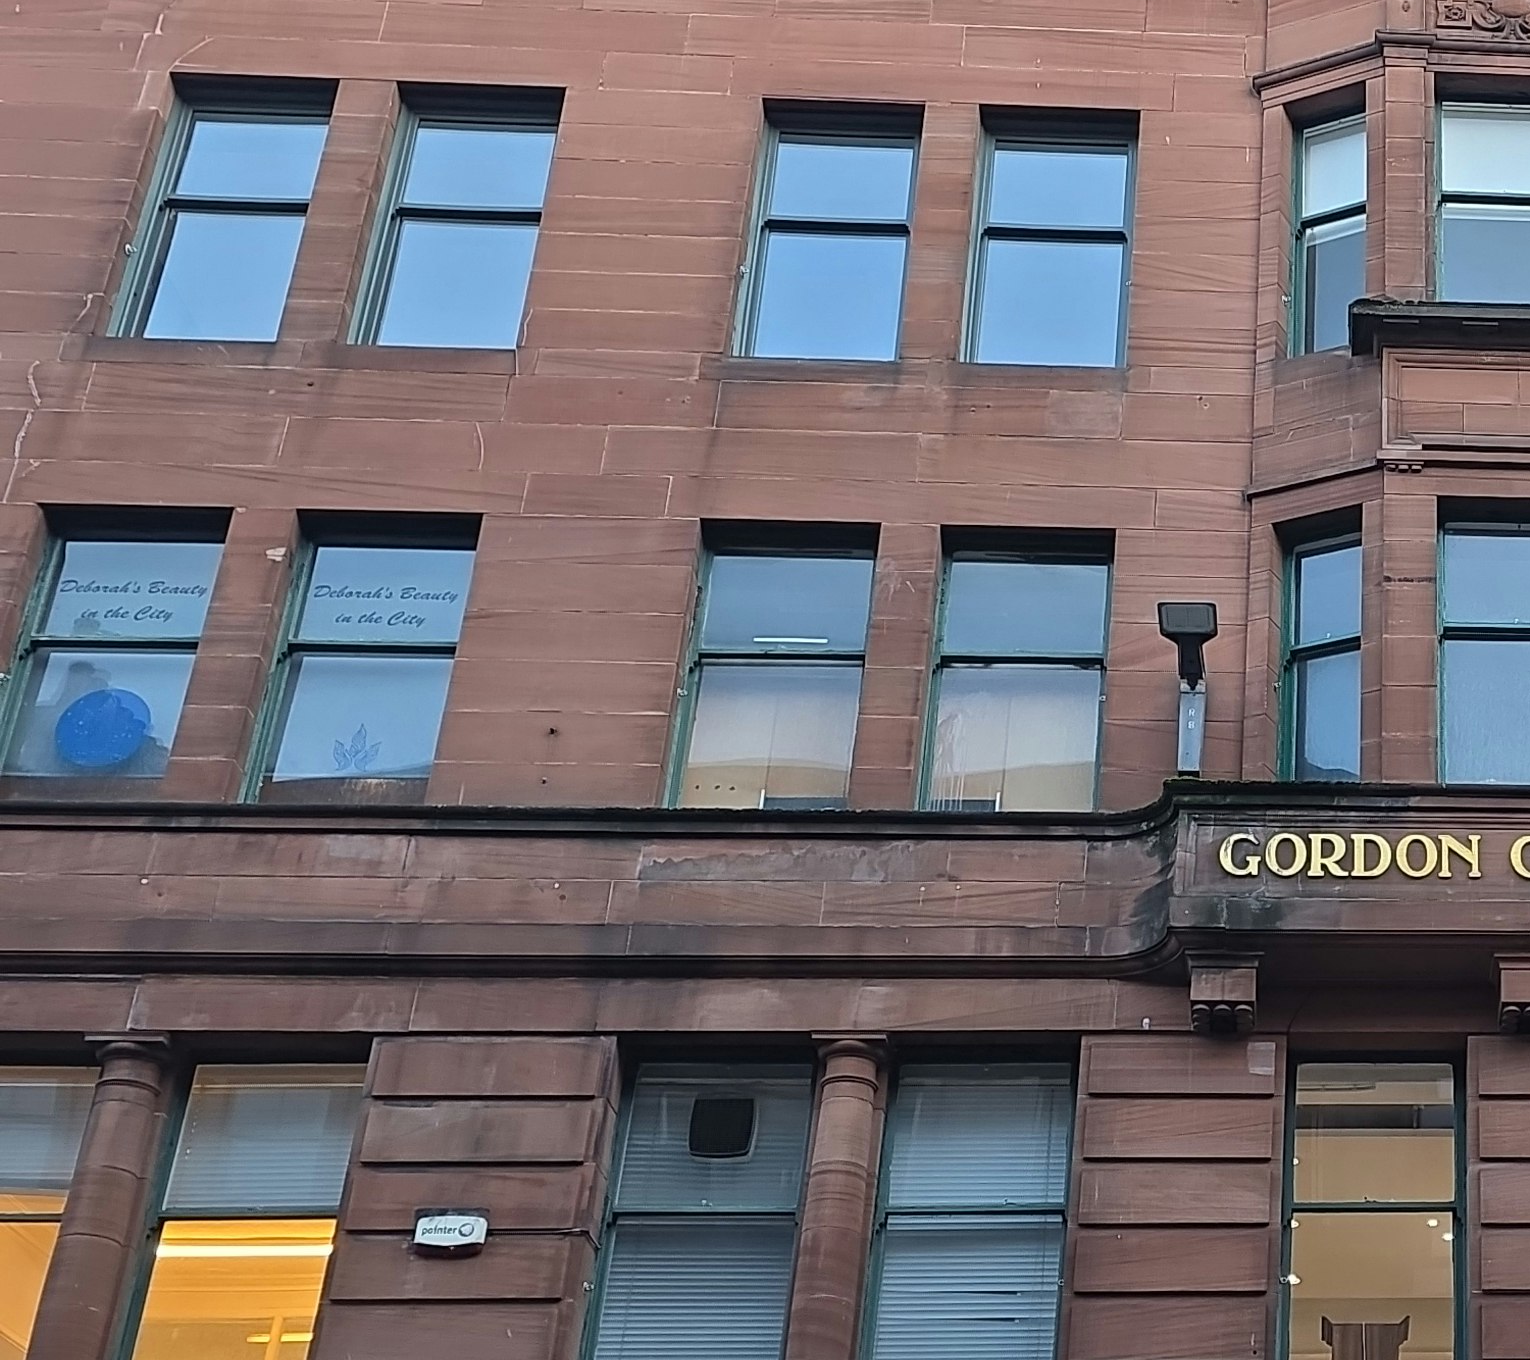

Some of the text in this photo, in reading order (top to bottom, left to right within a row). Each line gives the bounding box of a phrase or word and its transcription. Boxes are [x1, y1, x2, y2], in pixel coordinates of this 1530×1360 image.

[60, 579, 208, 597] Deborah's Beauty
[313, 584, 459, 604] Deborah's Beauty
[81, 605, 173, 622] in the City
[335, 611, 426, 628] in the City
[1218, 832, 1481, 879] GORDON
[421, 1224, 457, 1236] pointer
